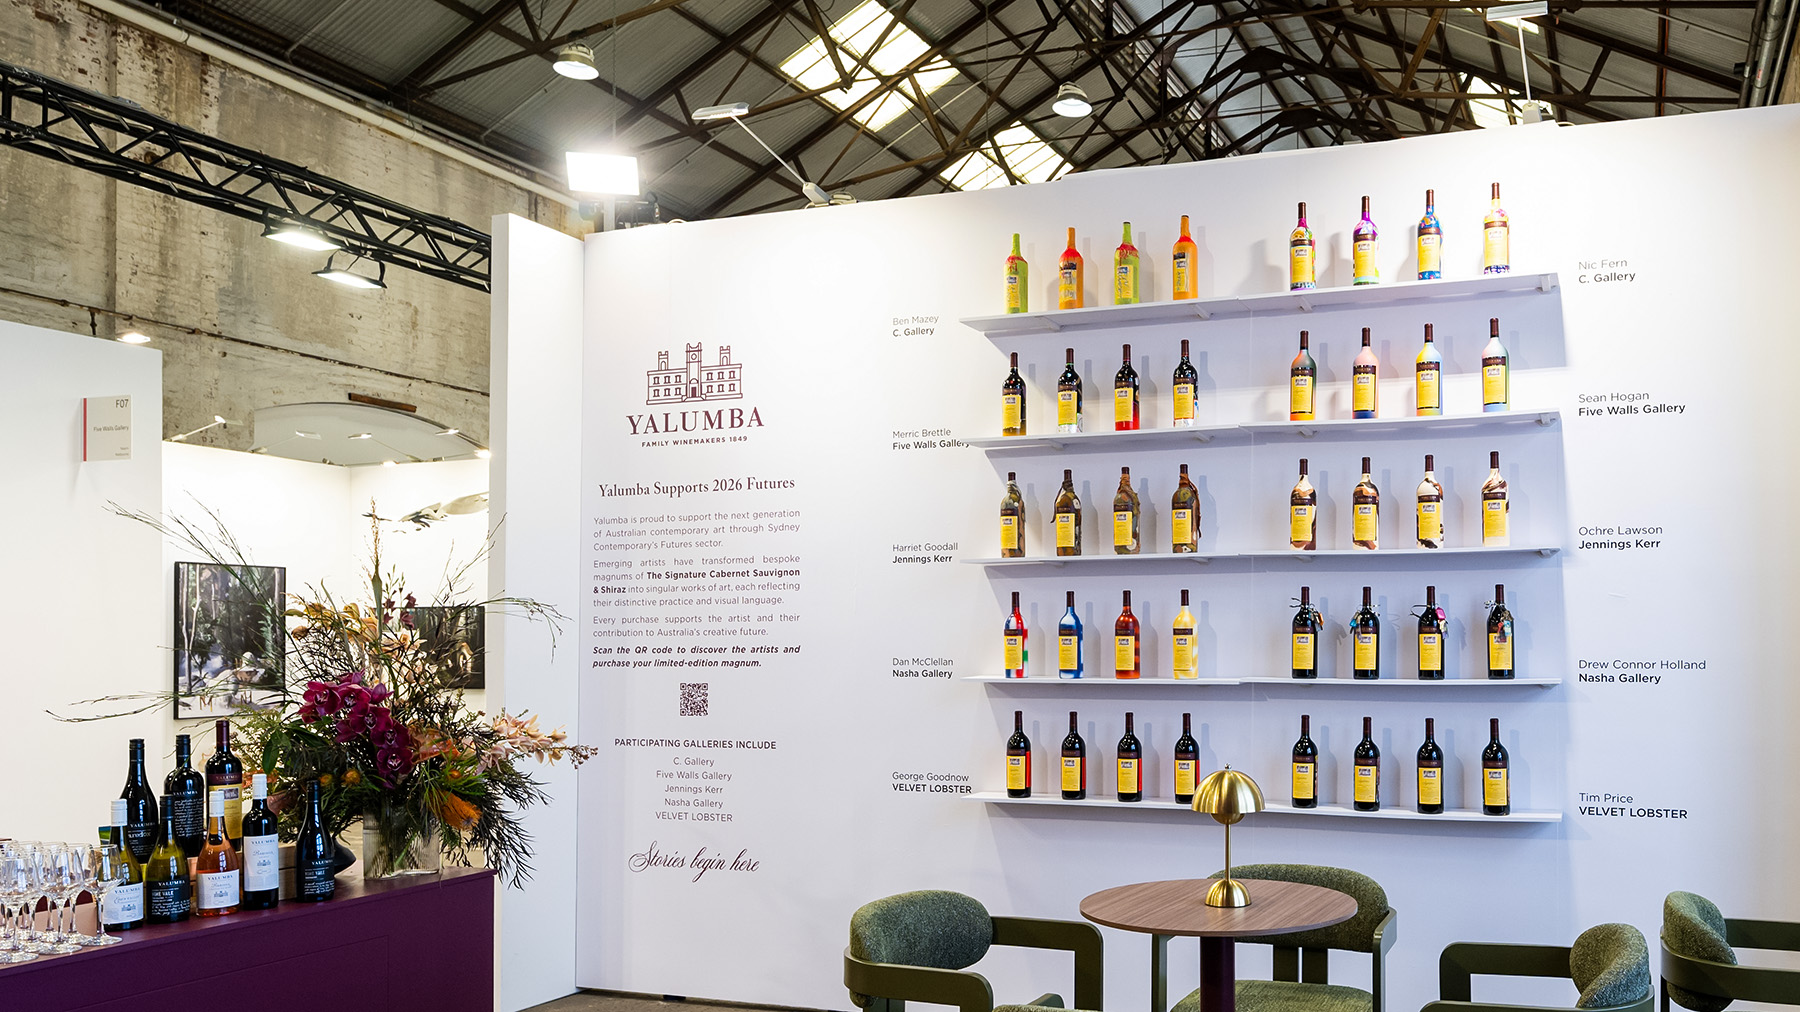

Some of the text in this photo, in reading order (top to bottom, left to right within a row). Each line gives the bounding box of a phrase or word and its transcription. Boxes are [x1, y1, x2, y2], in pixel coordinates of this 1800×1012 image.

[1578, 259, 1628, 270] Nic Fern
[1578, 272, 1636, 284] C. Gallery
[893, 316, 939, 326] Ben Mazey
[892, 327, 935, 337] C. Gallery
[1578, 392, 1649, 403] Sean Hogan
[115, 399, 129, 408] F07
[1579, 403, 1686, 416] Five Walls Gallery
[626, 406, 764, 435] YALUMBA
[922, 428, 951, 437] Brettle
[672, 437, 726, 446] WINEMAKERS
[893, 442, 911, 450] Five
[913, 440, 937, 449] Walls
[599, 477, 795, 498] Yalumba Supports 2026 Futures
[593, 516, 628, 525] Yalumba
[640, 514, 664, 524] proud
[678, 513, 711, 523] support
[714, 512, 728, 520] the
[731, 511, 750, 519] next
[752, 510, 800, 520] generation
[593, 523, 800, 538] of Australian contemporary art through Sydney
[1578, 526, 1663, 536] Ochre Lawson
[593, 540, 723, 551] Contemporary's Futures sector.
[893, 542, 958, 552] Harriet Goodall
[1578, 539, 1661, 550] Jennings Kerr
[593, 554, 800, 569] Emerging artists have transformed bespoke
[892, 554, 952, 564] Jennings Kerr
[594, 574, 632, 582] magnums
[635, 572, 643, 580] of
[665, 571, 706, 580] Signature
[709, 570, 750, 578] Cabernet
[753, 568, 800, 578] Sauvignon
[593, 586, 599, 594] &
[601, 585, 626, 594] Shiraz
[646, 584, 679, 594] singular
[681, 584, 706, 592] works
[708, 583, 717, 592] of
[718, 584, 733, 592] art,
[735, 582, 756, 591] each
[758, 582, 800, 591] reflecting
[593, 596, 784, 607] their distinctive practice and visual language.
[593, 613, 800, 625] Every purchase supports the artist and their
[593, 627, 768, 637] contribution to Australia's creative future.
[593, 645, 801, 654] Scan the QR code to discover the artists and
[592, 659, 630, 668] purchase
[654, 659, 719, 667] limited-edition
[721, 660, 761, 668] magnum.
[892, 657, 953, 666] Dan McClellan
[1579, 660, 1706, 670] Drew Connor Holland
[893, 669, 953, 679] Nasha Gallery
[1579, 673, 1661, 685] Nasha Gallery
[615, 738, 776, 749] PARTICIPATING GALLERIES INCLUDE
[673, 757, 715, 767] C. Gallery
[656, 770, 732, 782] Five Walls Gallery
[892, 771, 969, 782] George Goodnow
[664, 784, 723, 795] Jennings Kerr
[892, 783, 972, 794] VELVET LOBSTER
[665, 798, 723, 809] Nasha Gallery
[1579, 792, 1633, 804] Tim Price
[655, 811, 733, 822] VELVET LOBSTER
[1579, 806, 1687, 819] VELVET LOBSTER
[628, 840, 760, 883] Stories begin here
